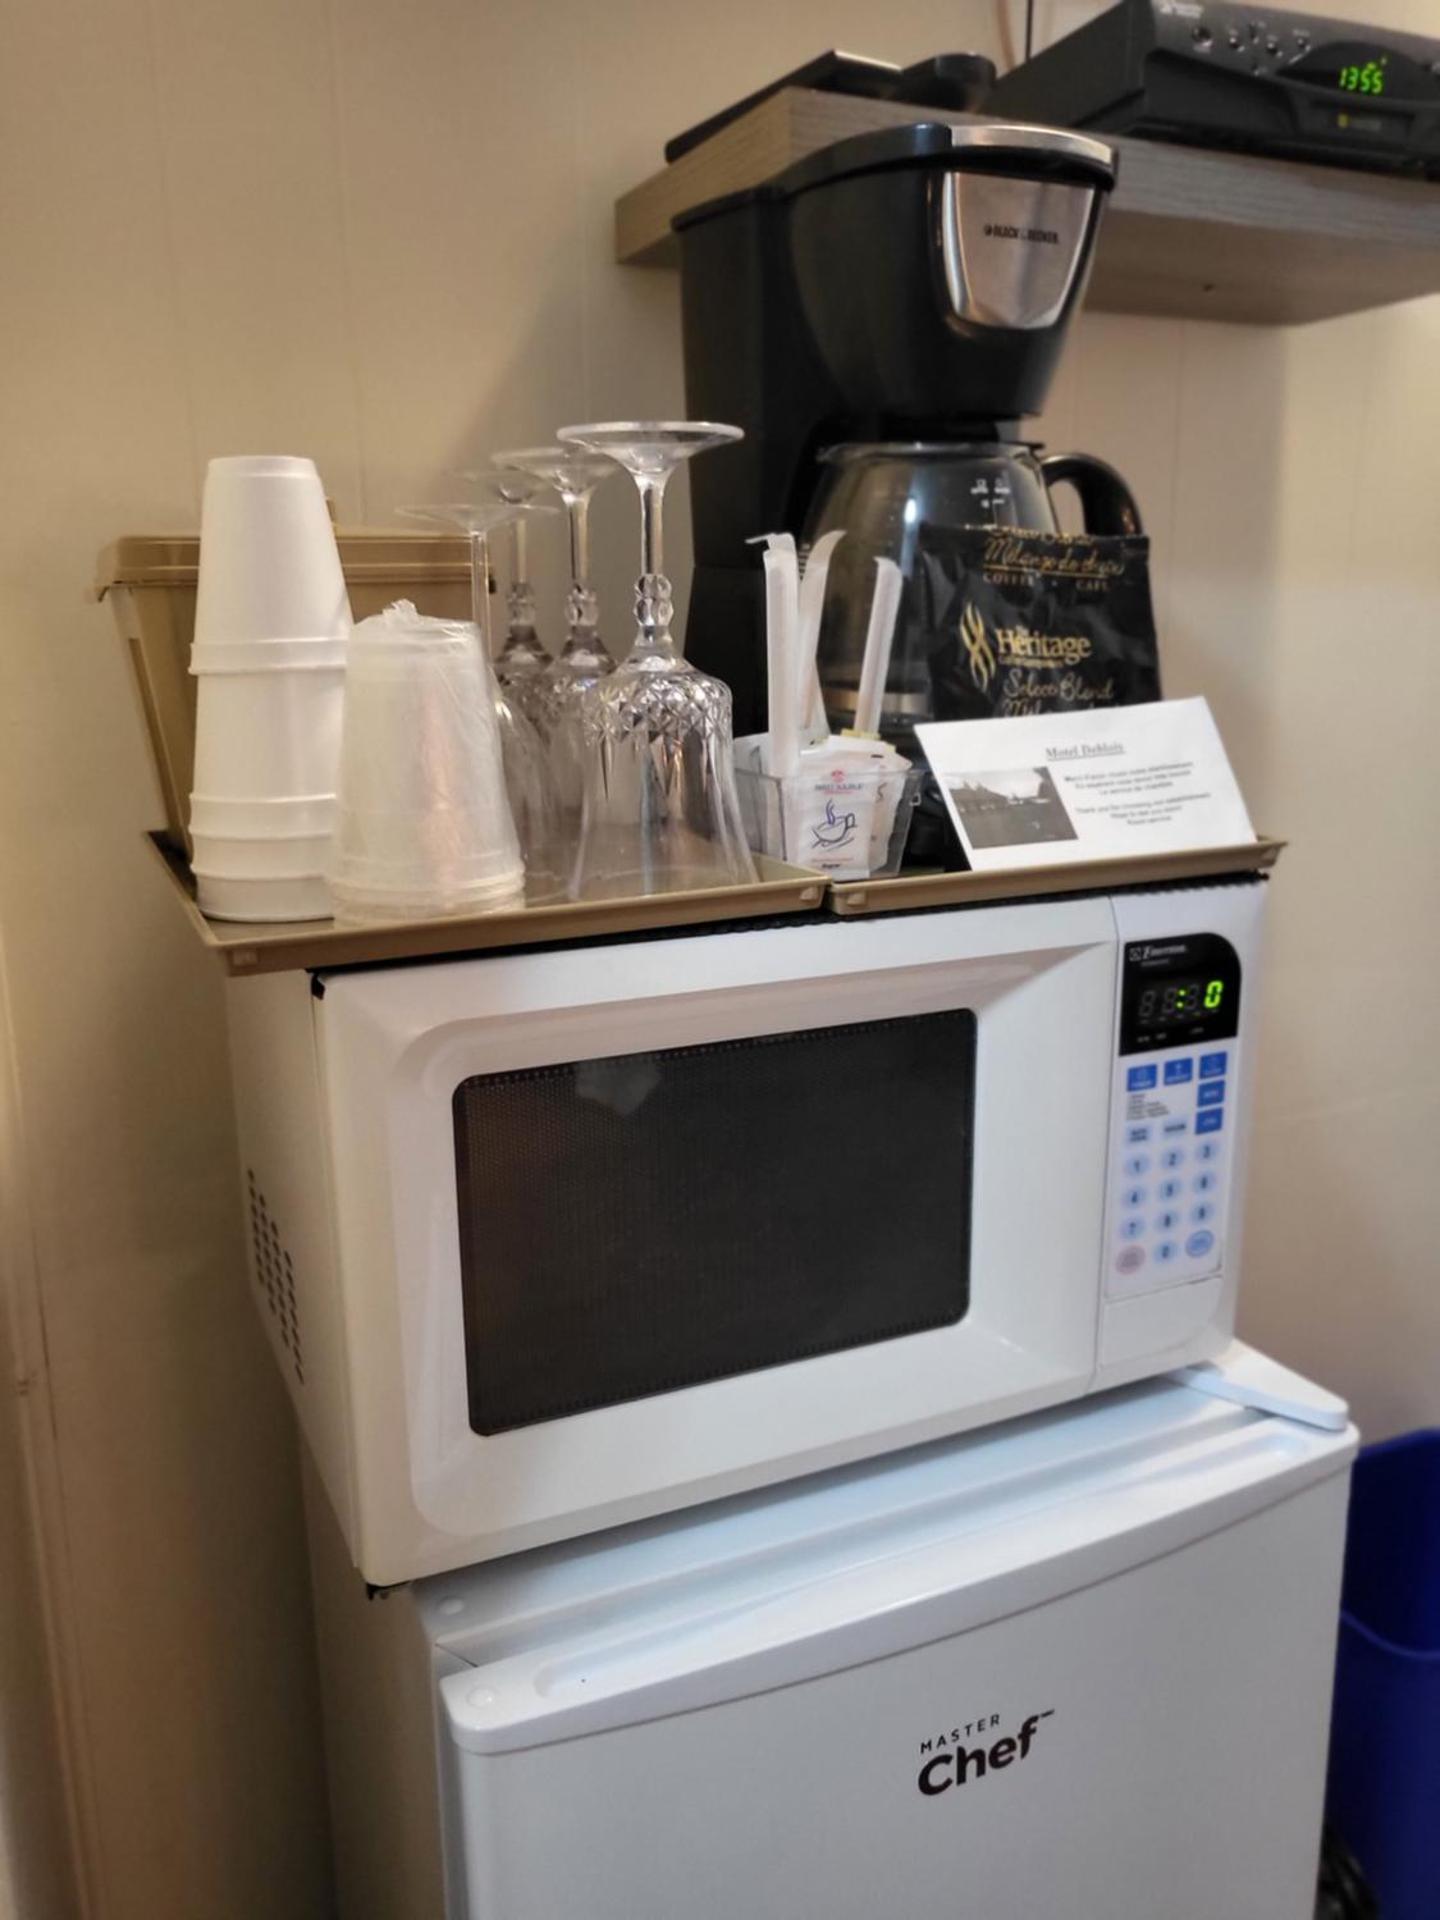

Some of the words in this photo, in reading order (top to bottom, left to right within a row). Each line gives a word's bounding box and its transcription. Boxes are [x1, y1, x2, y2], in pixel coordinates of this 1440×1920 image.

[1340, 66, 1383, 94] 1355
[920, 1714, 1000, 1754] MASTER
[918, 1714, 1041, 1796] Chef
